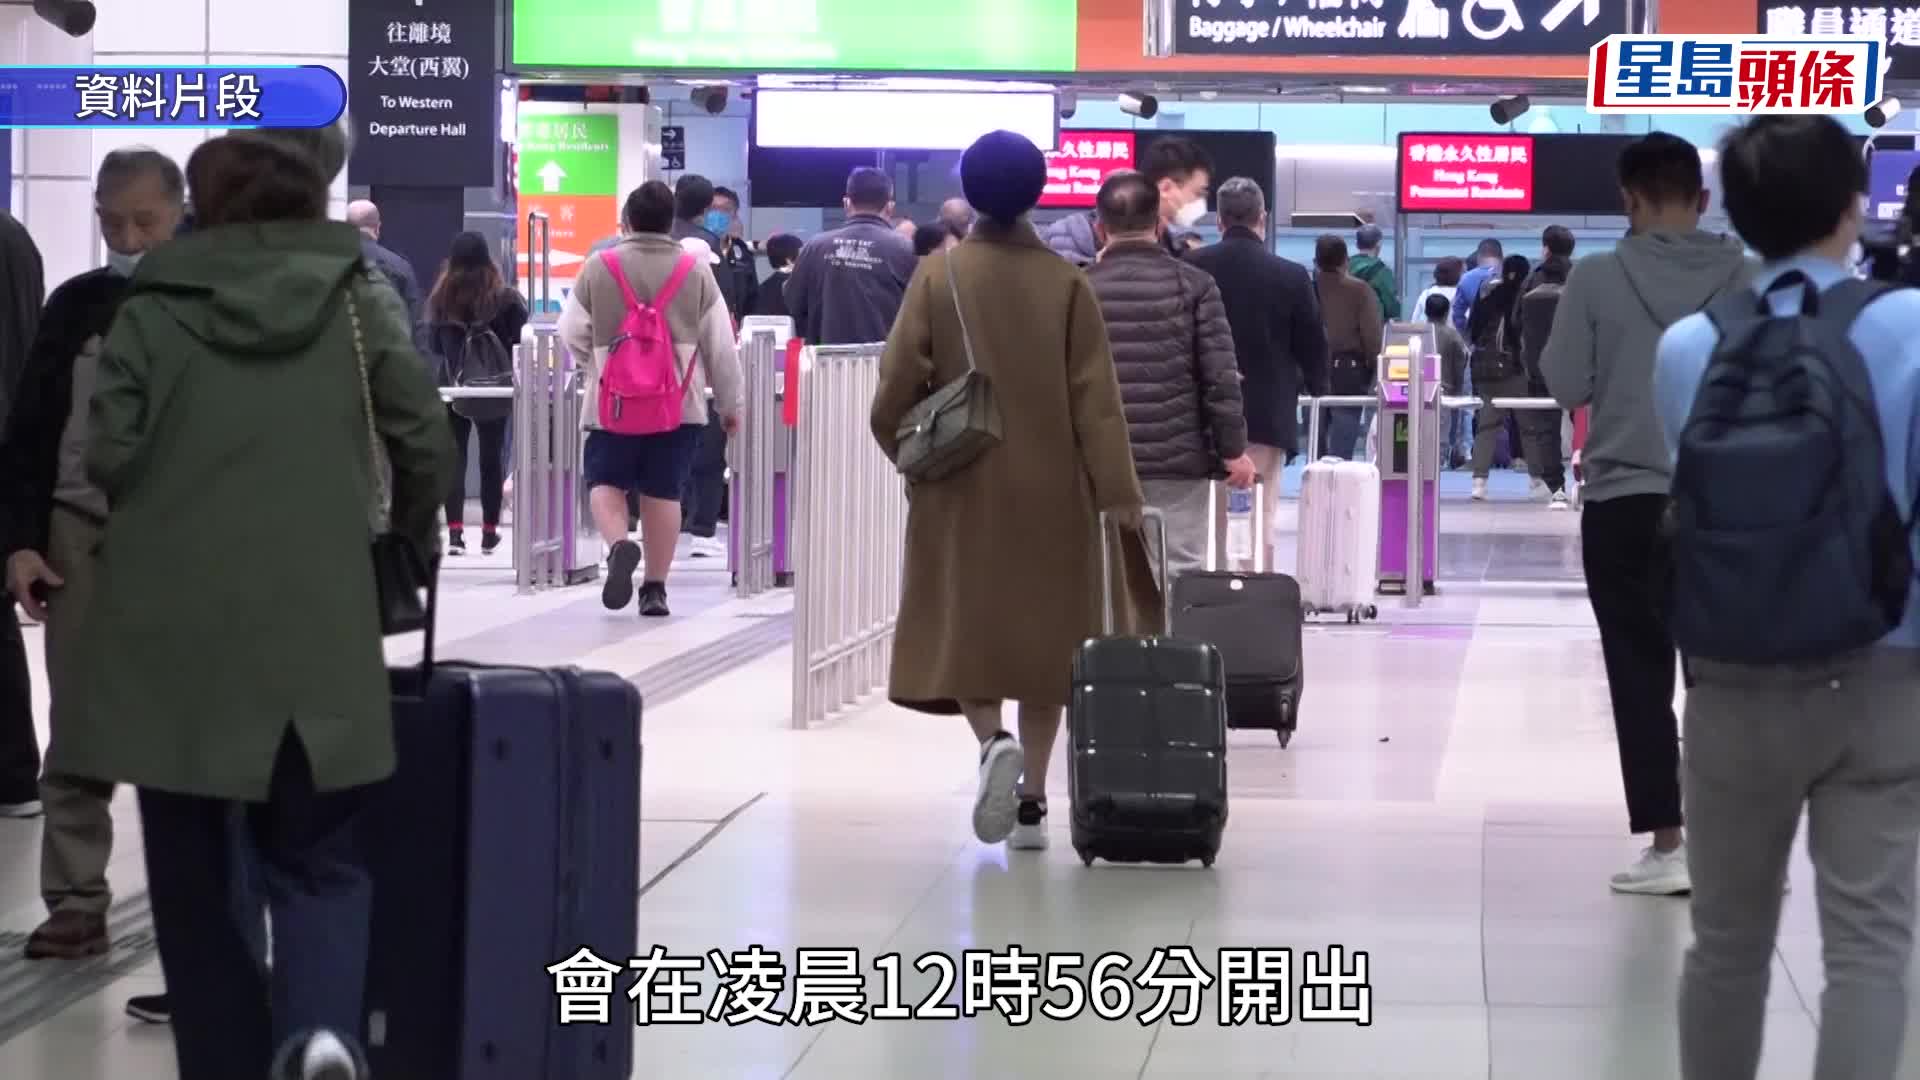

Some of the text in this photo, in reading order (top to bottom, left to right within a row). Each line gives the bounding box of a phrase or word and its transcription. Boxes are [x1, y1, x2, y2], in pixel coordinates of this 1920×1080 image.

[387, 21, 452, 44] 往離境
[1189, 15, 1387, 42] Baggage / Wheelchair
[368, 55, 470, 80] 大堂(西翼)
[380, 95, 454, 109] To Western
[369, 121, 467, 137] Departure Hall
[1409, 143, 1528, 164] 香港永久性居民
[1433, 169, 1498, 184] Hong Kong
